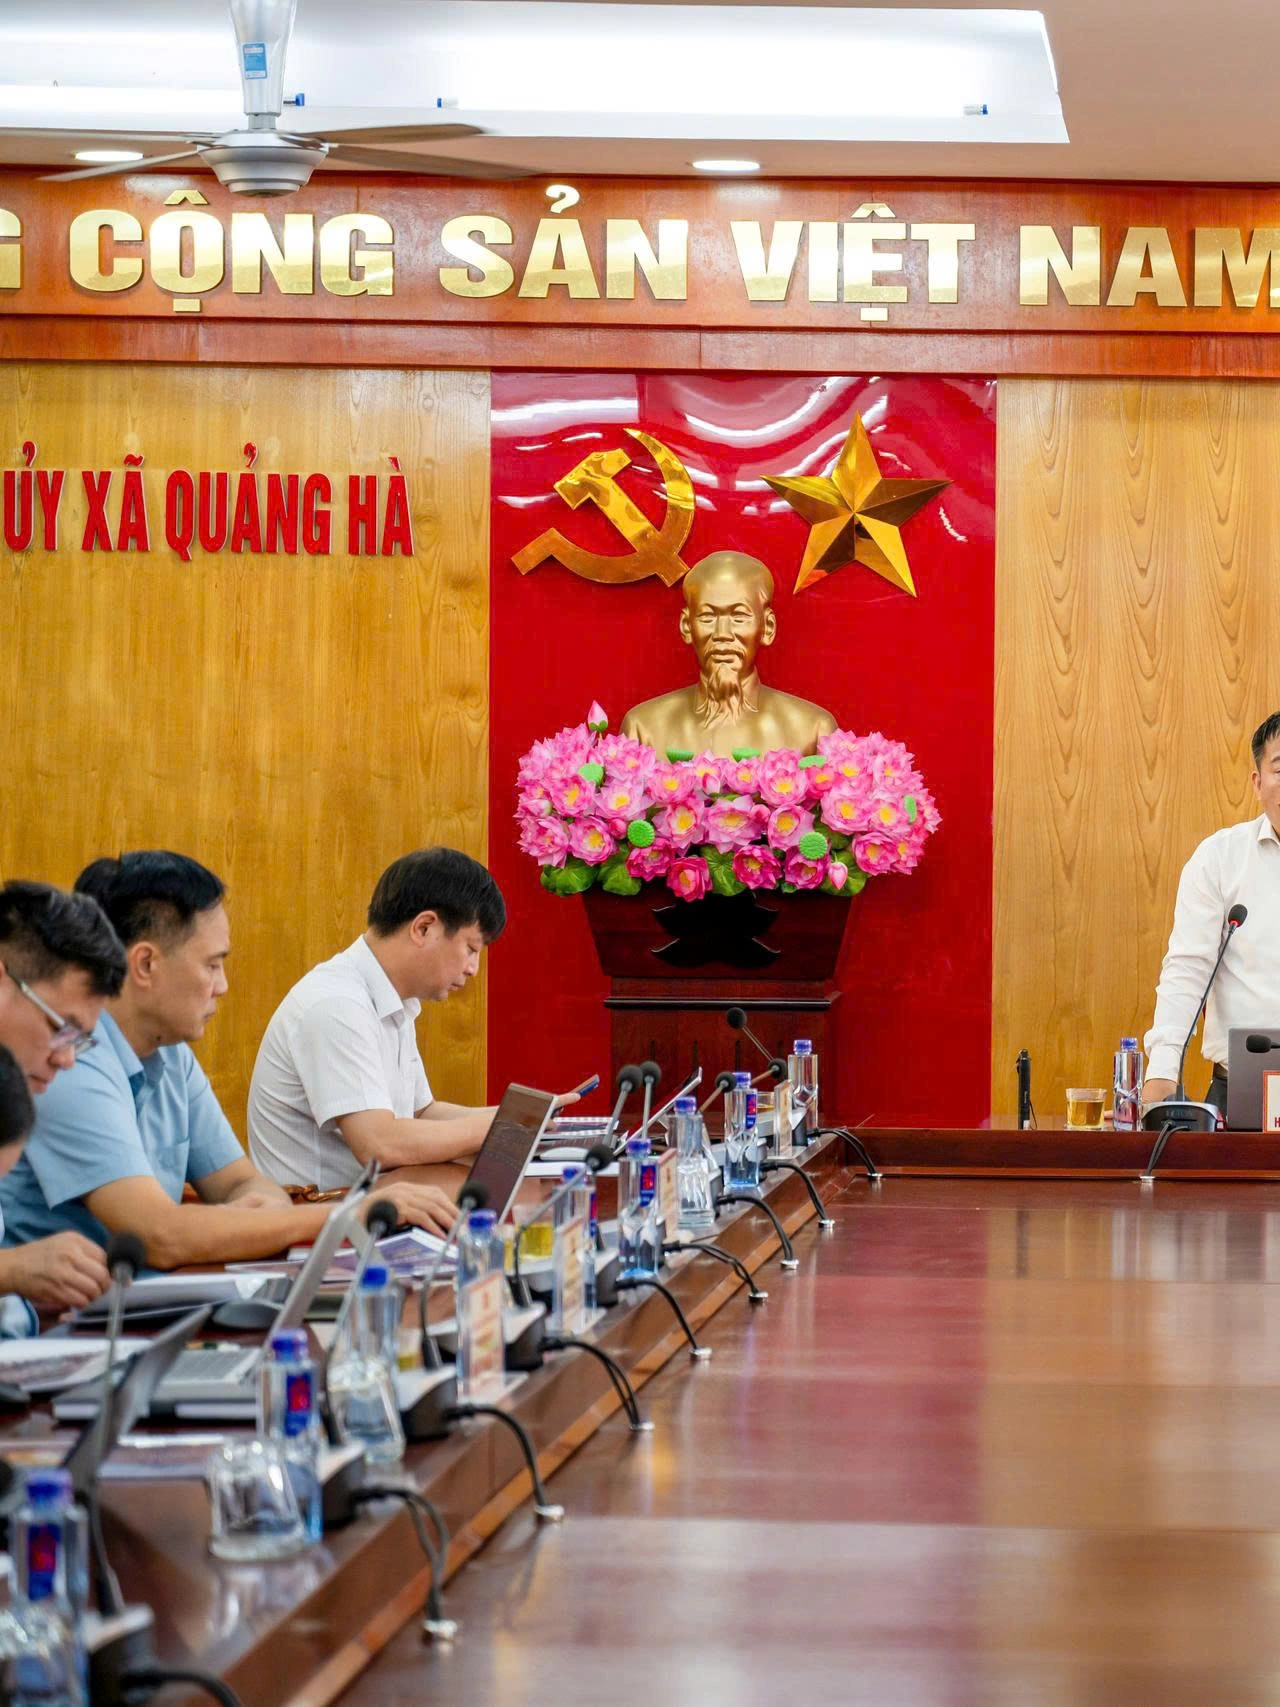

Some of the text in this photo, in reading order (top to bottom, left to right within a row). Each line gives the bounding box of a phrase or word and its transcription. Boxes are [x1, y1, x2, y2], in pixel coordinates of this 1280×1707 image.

[69, 189, 395, 312] CỘNG
[439, 184, 689, 302] SẢN
[730, 202, 976, 322] VIỆT
[3, 440, 415, 561] ỦY XÃ QUẢNG HÀ
